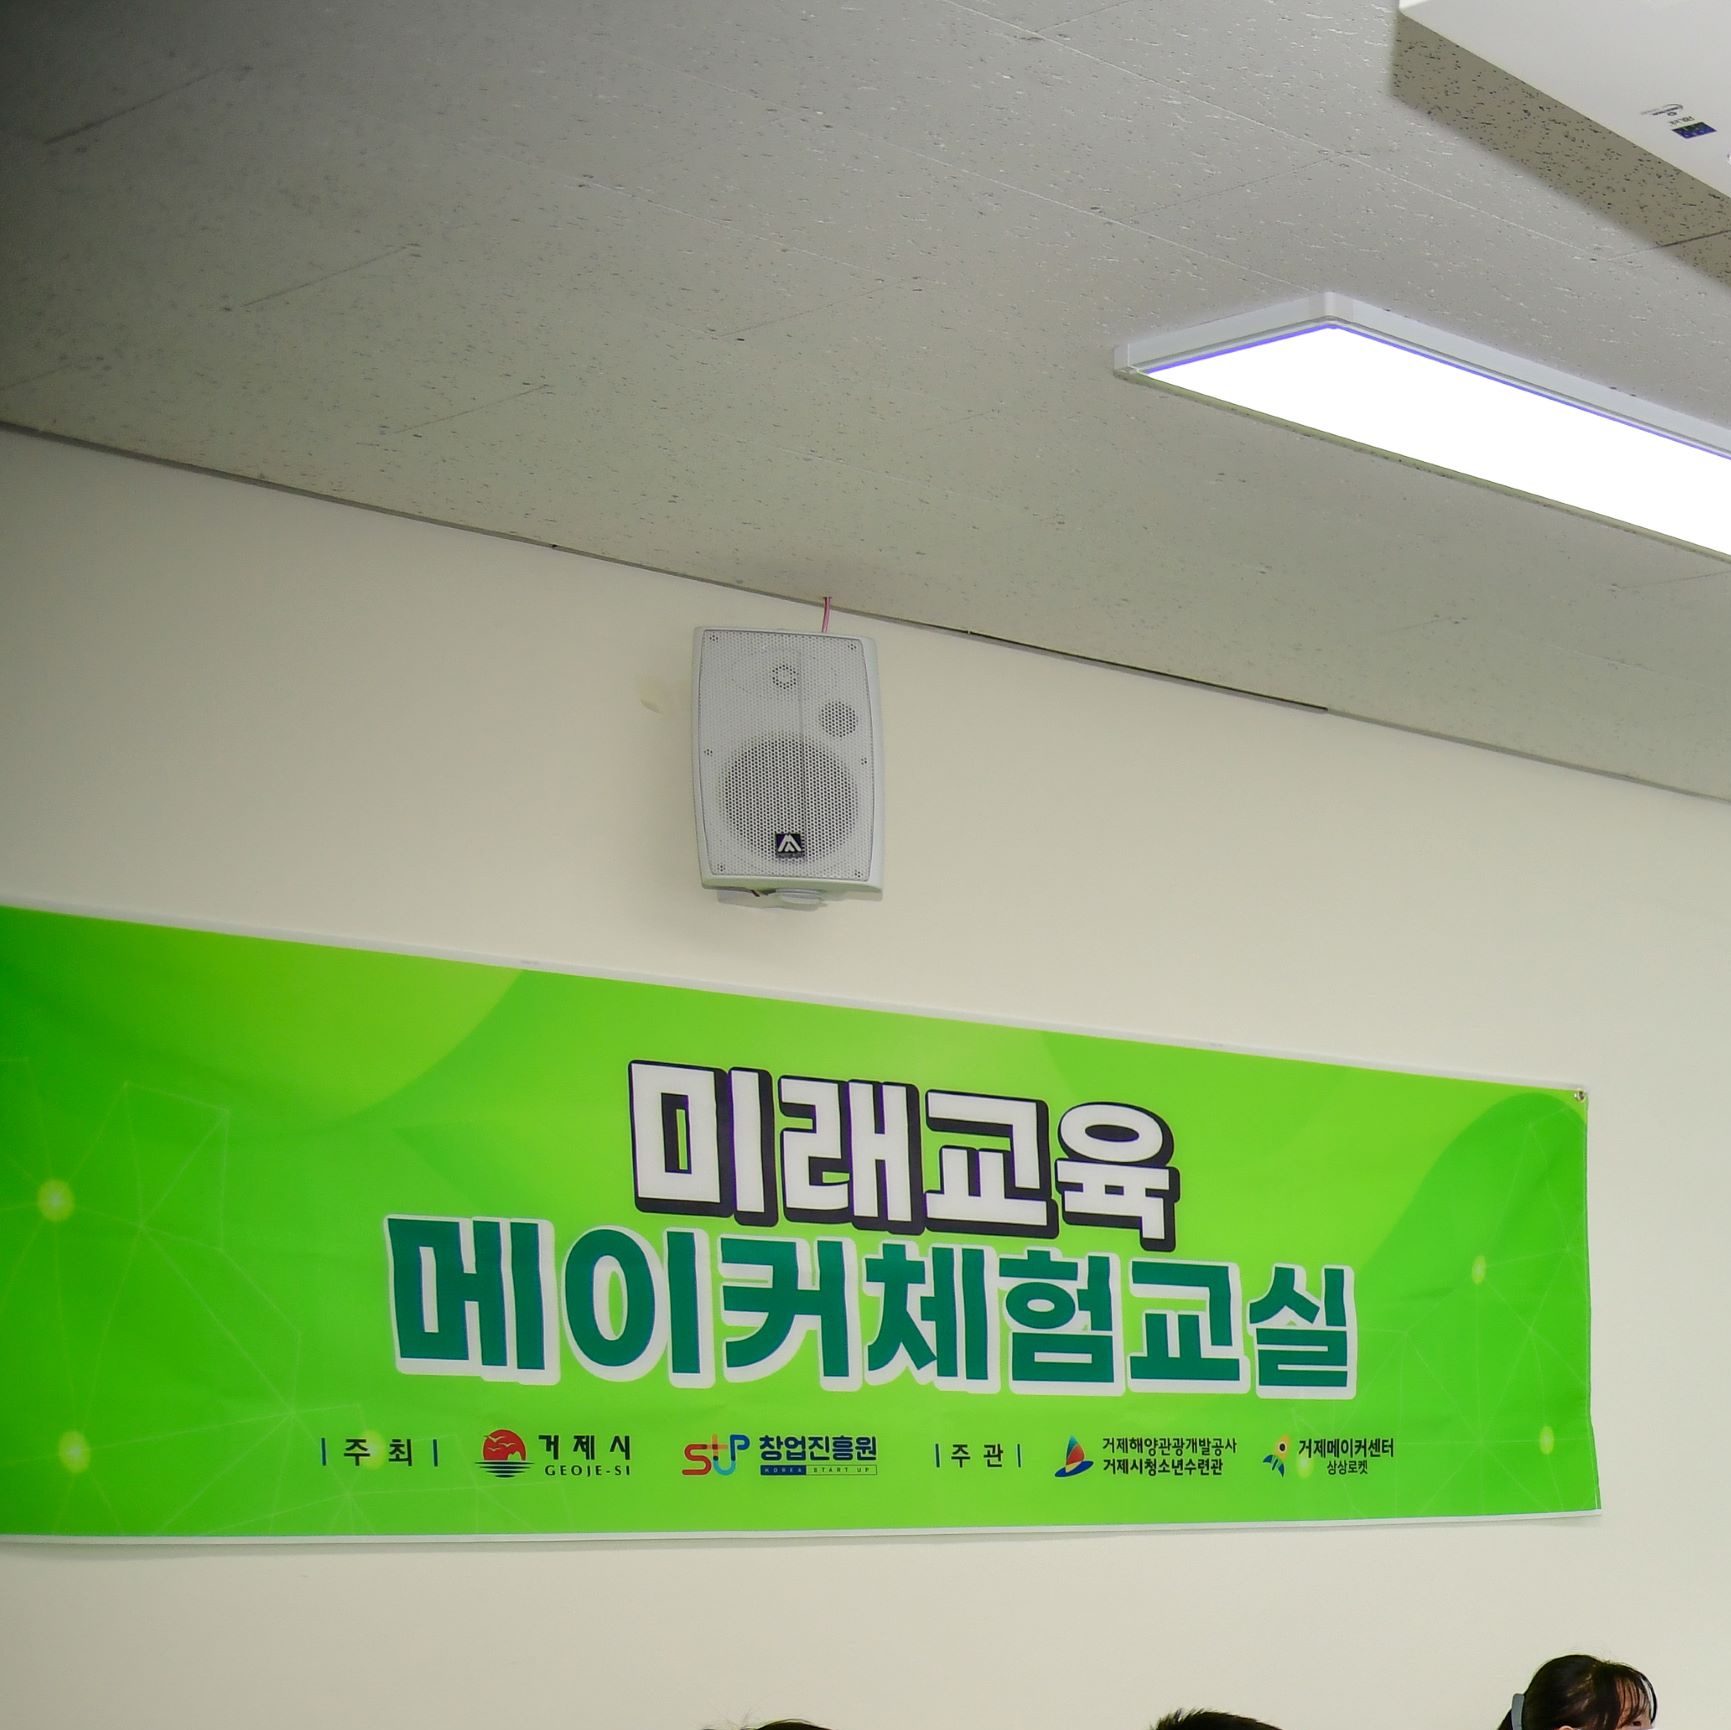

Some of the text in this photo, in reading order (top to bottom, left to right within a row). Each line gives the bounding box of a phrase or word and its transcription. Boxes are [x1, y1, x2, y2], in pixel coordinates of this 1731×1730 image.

[628, 1060, 1179, 1252] 미래교육
[384, 1214, 1356, 1399] 메이커체험교실
[343, 1438, 413, 1467] 주최
[538, 1434, 631, 1460] 거제시
[759, 1434, 877, 1461] 창업진흥원
[950, 1443, 1004, 1468] 주관
[1102, 1436, 1237, 1456] 거제해양관광개발공사
[1298, 1438, 1394, 1459] 거제메이커센터
[544, 1464, 631, 1476] GEOJE-SI
[1103, 1458, 1223, 1476] 거제시청소년수련관
[1327, 1460, 1368, 1475] 상상로켓
